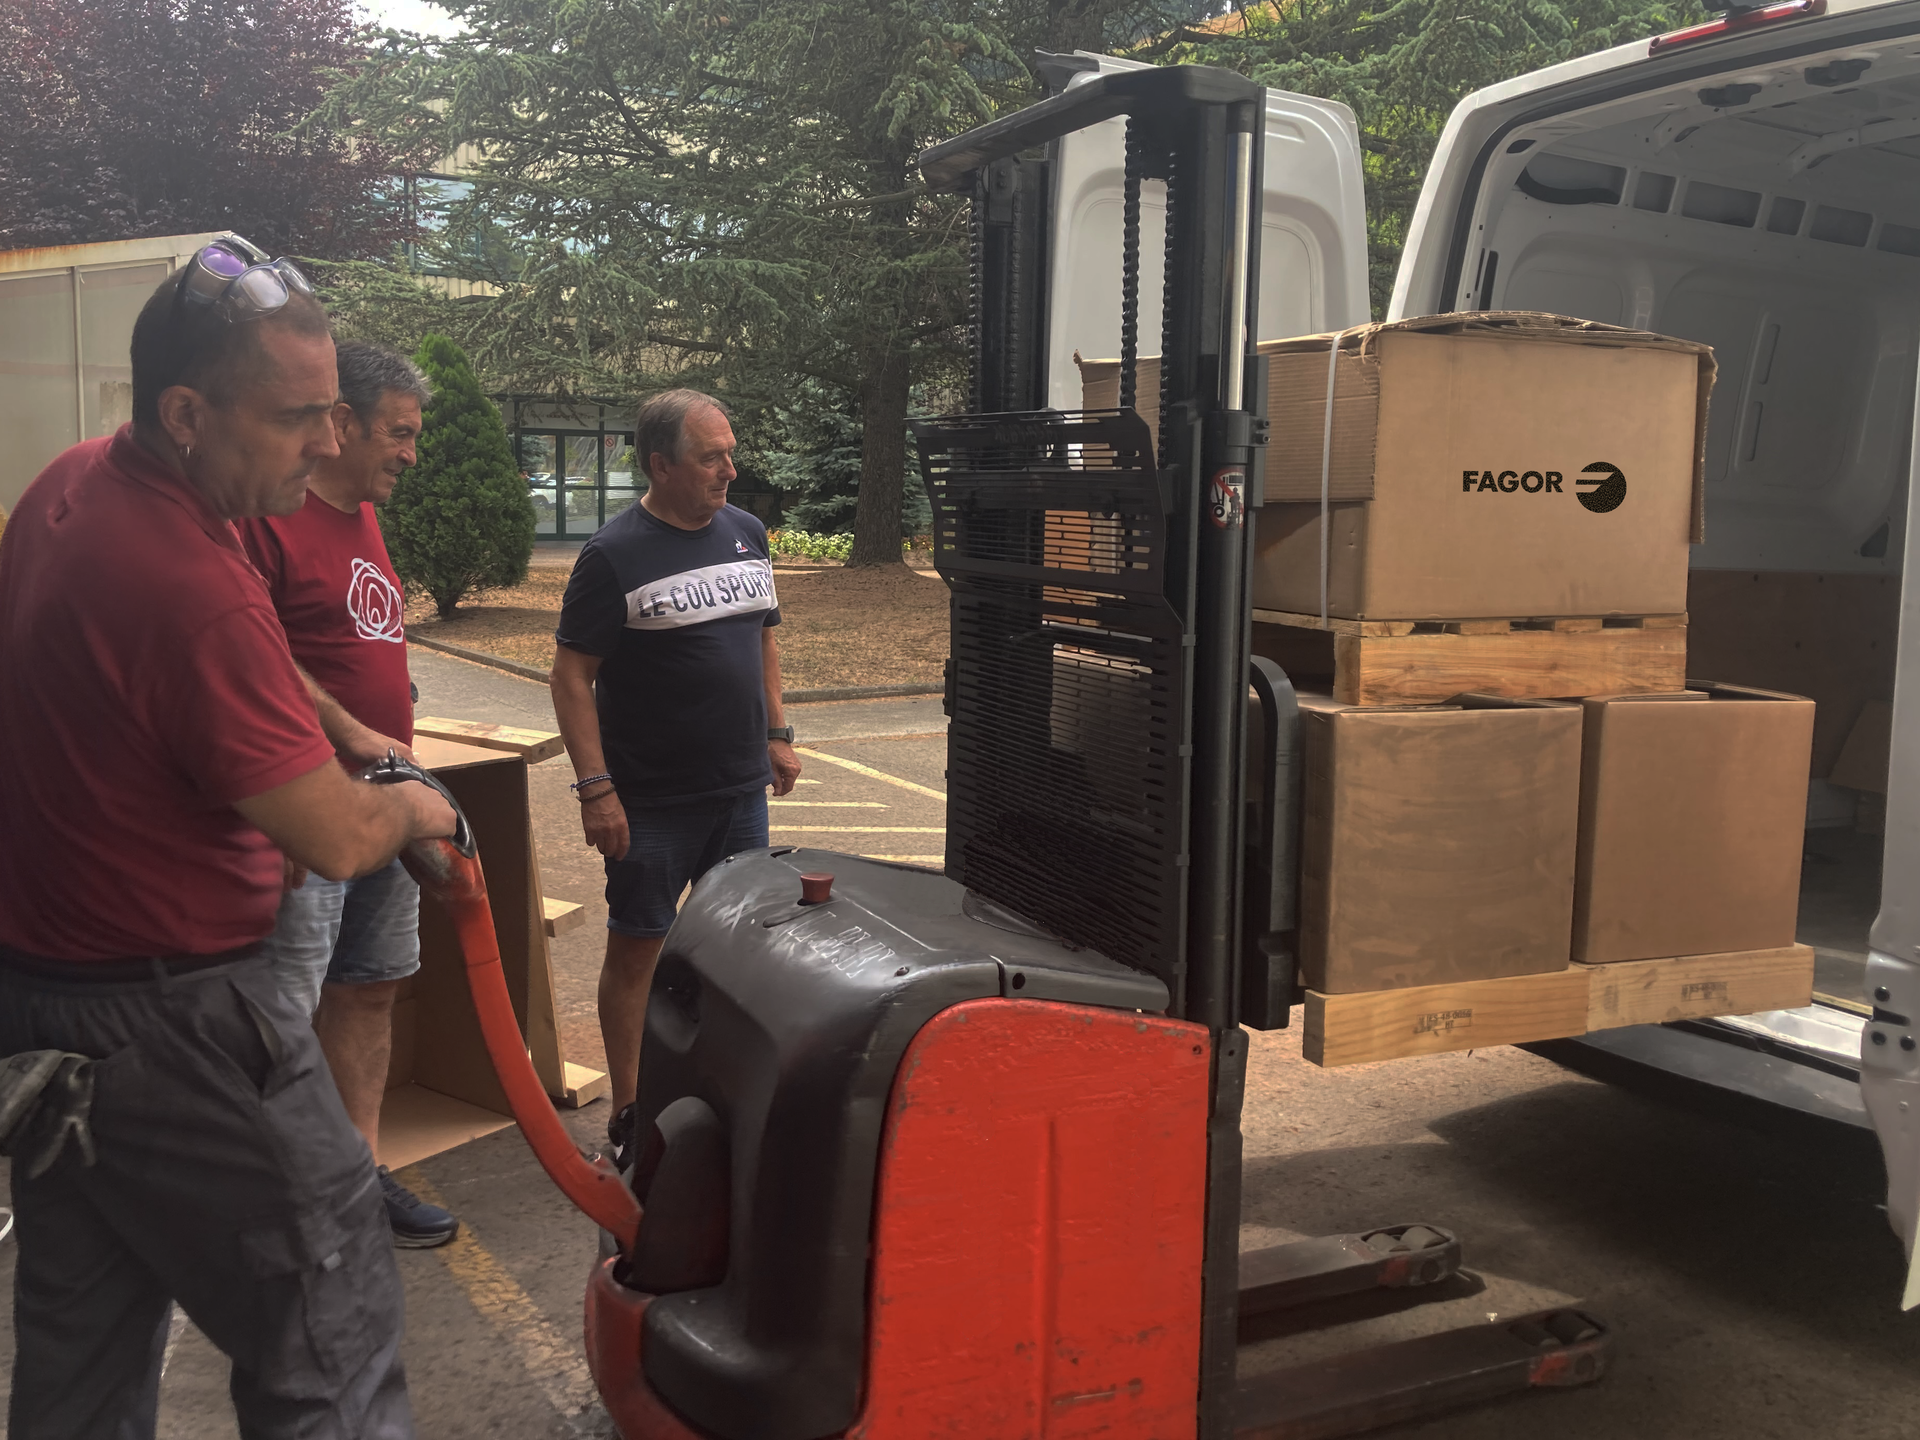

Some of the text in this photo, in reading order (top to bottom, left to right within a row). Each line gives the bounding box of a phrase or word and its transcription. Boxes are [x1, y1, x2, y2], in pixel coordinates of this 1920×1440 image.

[1462, 470, 1564, 493] FAGOR
[638, 591, 666, 618] LE
[670, 579, 717, 612] COQ
